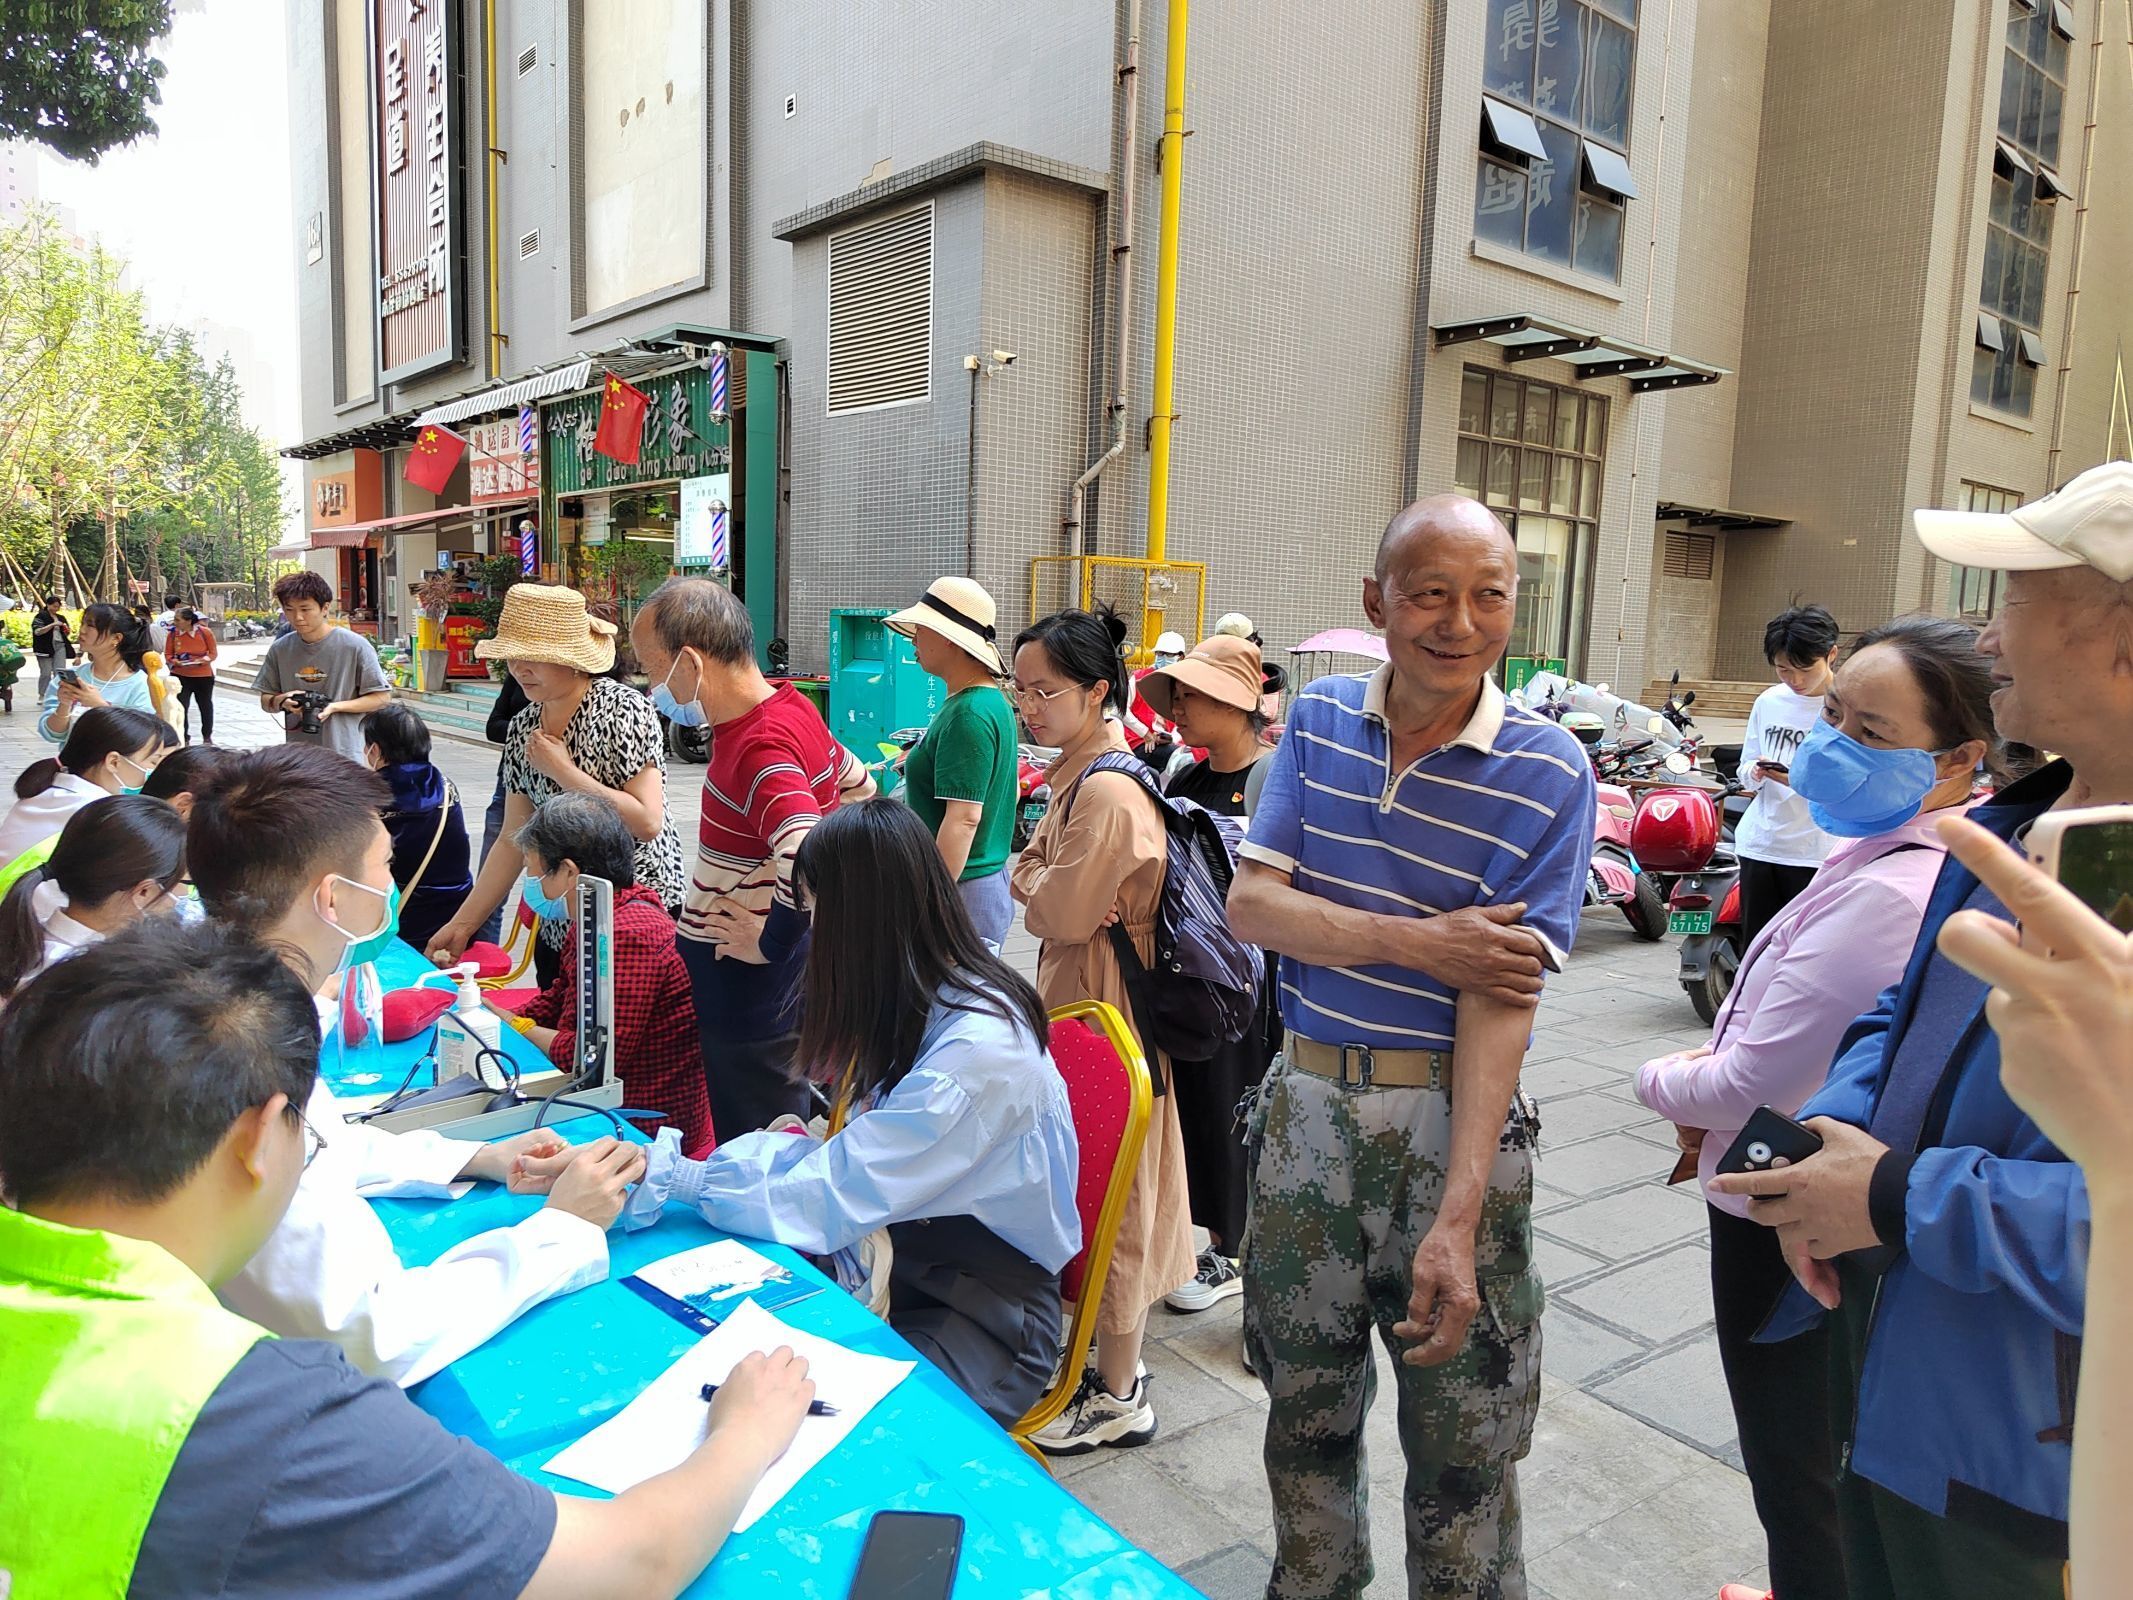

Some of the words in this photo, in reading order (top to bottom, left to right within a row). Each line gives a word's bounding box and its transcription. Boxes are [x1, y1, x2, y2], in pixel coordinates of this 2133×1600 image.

[636, 455, 660, 478] xing
[664, 453, 696, 473] xiang
[1765, 725, 1811, 756] THRO
[1671, 922, 1709, 932] 37175
